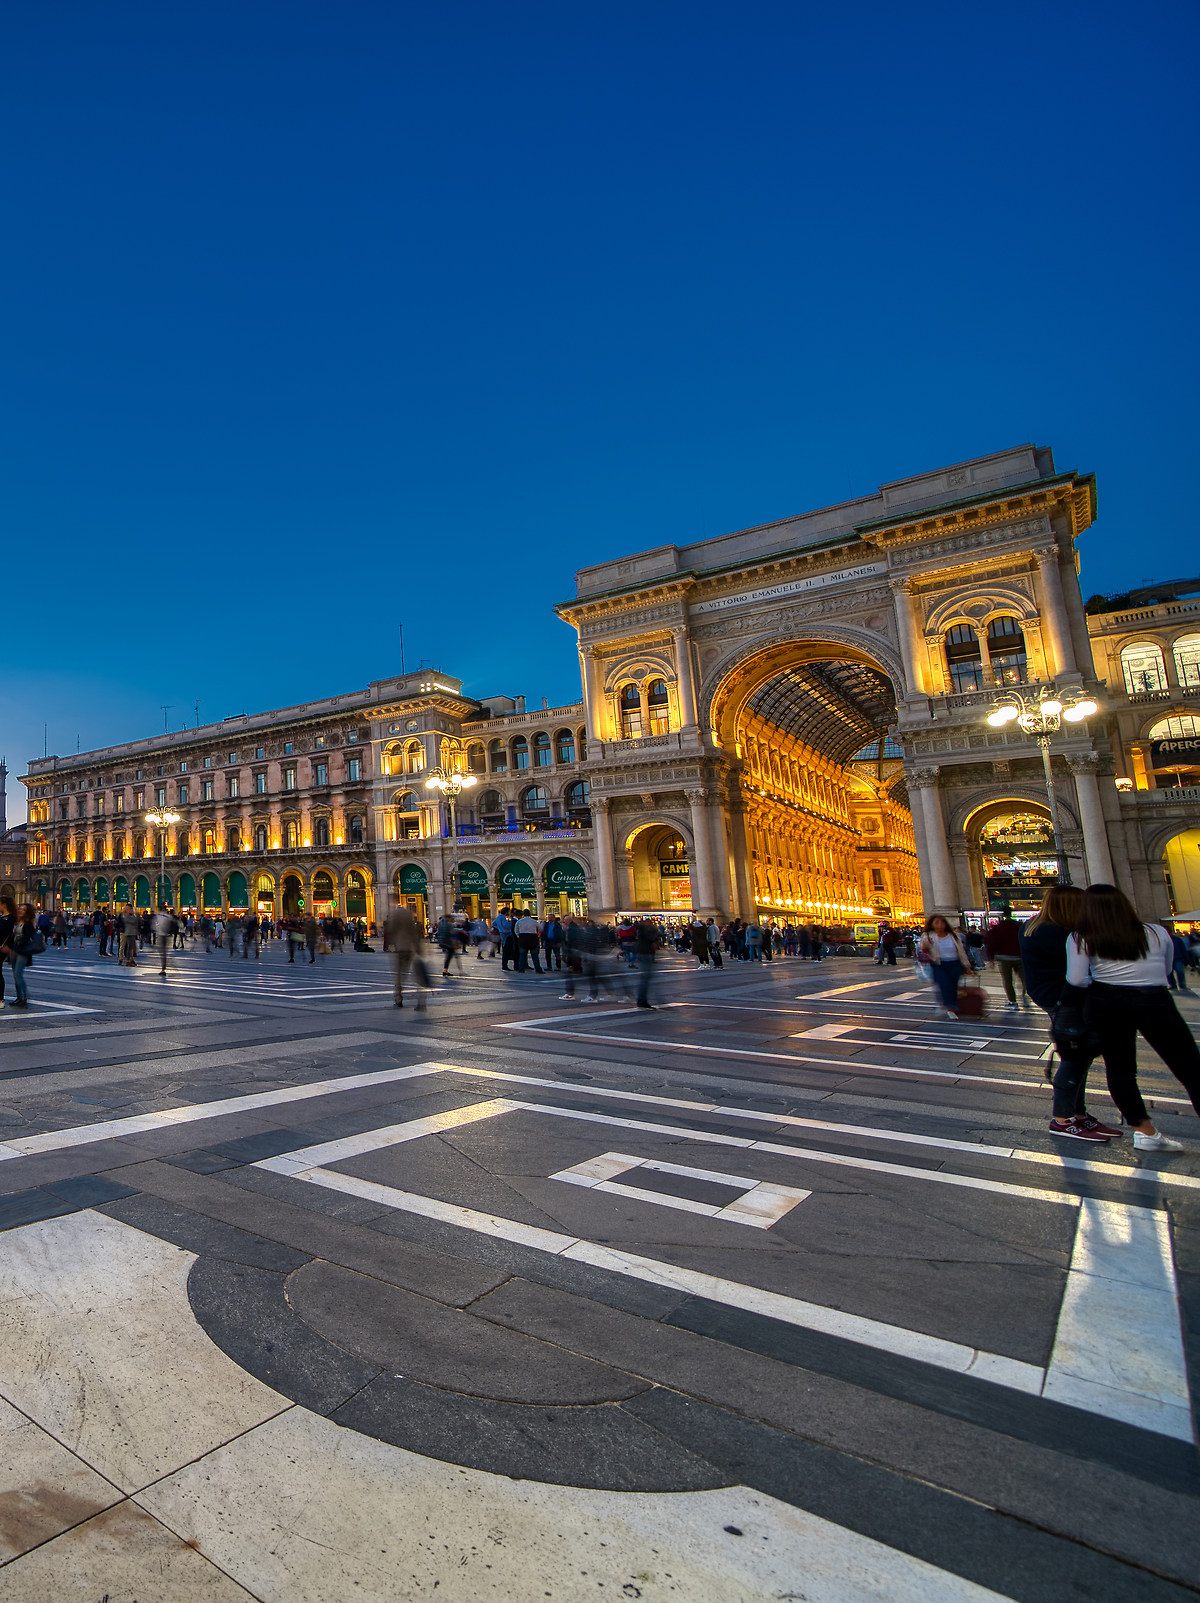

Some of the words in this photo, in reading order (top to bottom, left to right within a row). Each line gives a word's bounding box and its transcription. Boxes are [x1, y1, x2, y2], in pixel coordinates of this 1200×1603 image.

[708, 595, 748, 608] VITTORIO
[751, 583, 801, 599] EMANUELE
[830, 566, 877, 582] MILANESI
[1011, 877, 1041, 885] Motta
